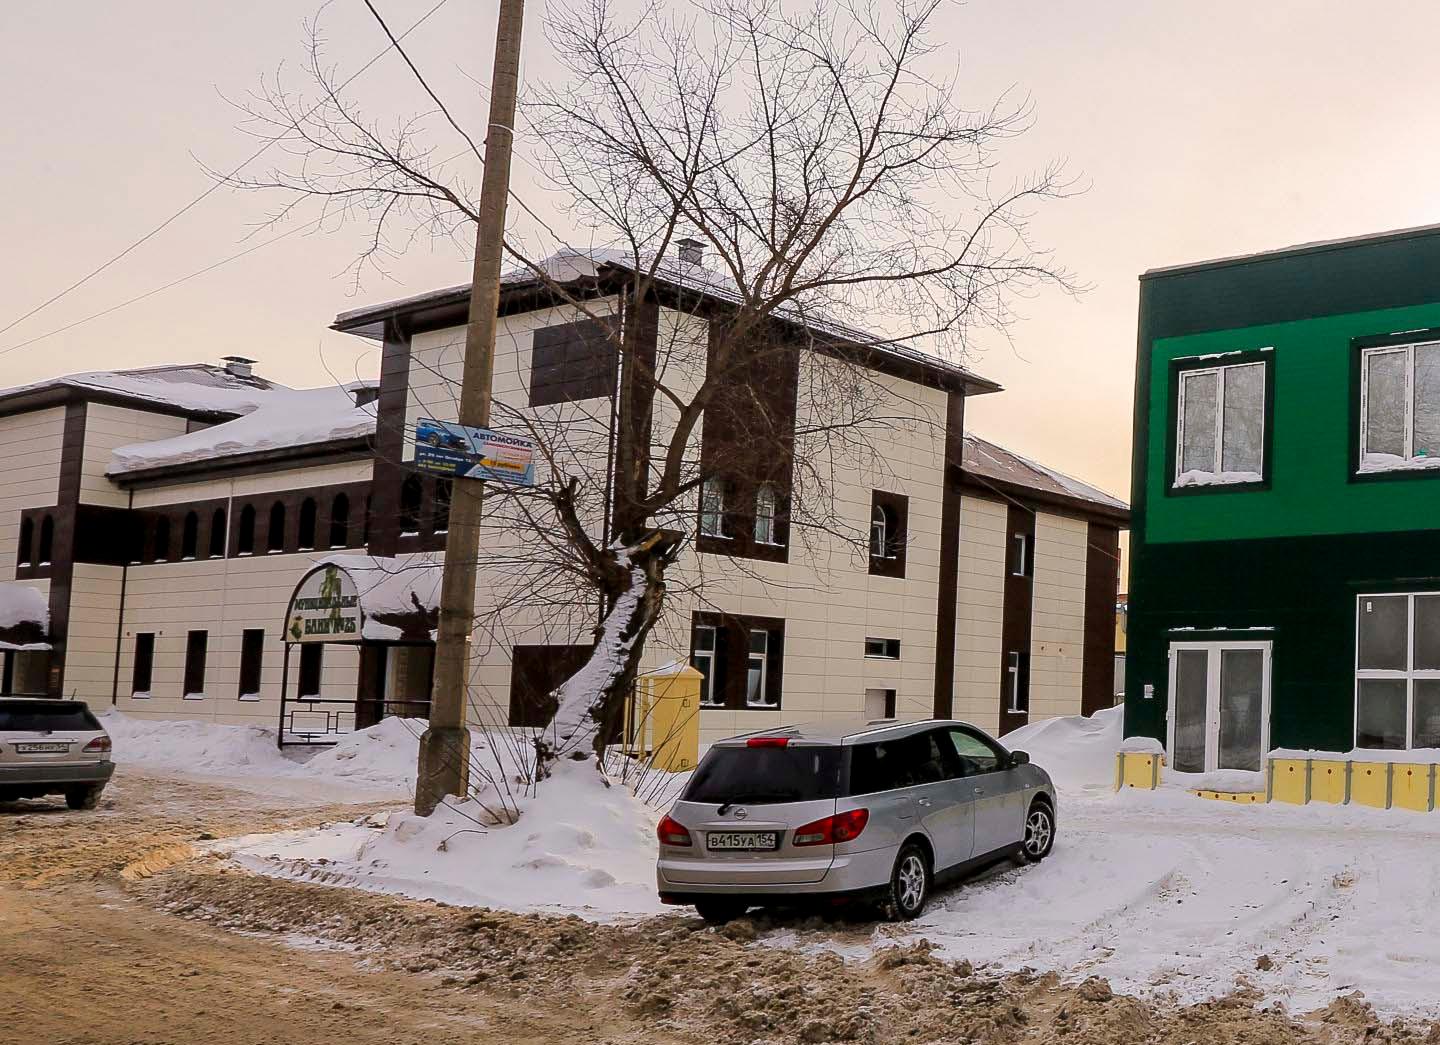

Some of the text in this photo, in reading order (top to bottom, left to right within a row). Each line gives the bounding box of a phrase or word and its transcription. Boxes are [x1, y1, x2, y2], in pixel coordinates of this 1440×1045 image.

[473, 433, 532, 448] АВТОМОЙКА
[304, 618, 330, 635] БАНИ
[711, 834, 773, 846] В415УА 154
